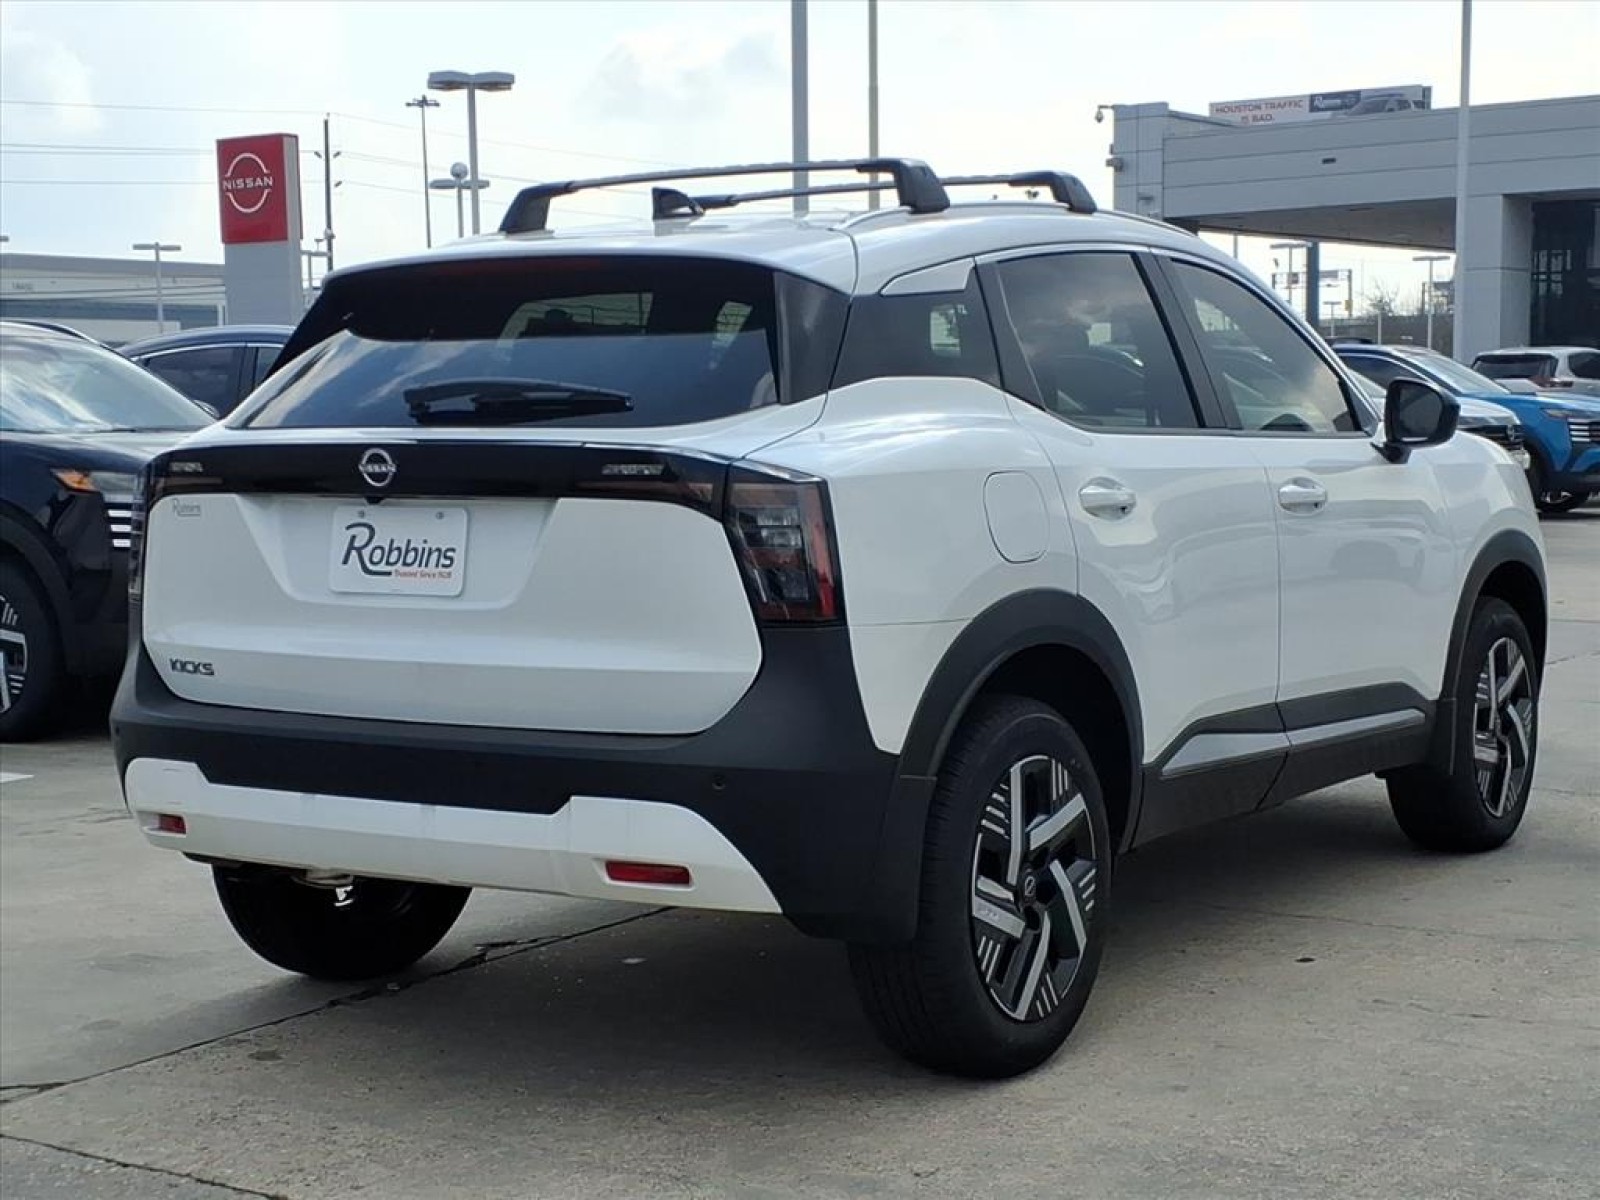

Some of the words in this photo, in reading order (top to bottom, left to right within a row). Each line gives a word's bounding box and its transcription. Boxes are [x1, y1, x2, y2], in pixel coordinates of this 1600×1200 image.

[1215, 103, 1262, 113] HOUSTON
[1264, 99, 1304, 110] TRAFFIC
[222, 176, 273, 190] NISSAN
[341, 521, 457, 576] Robbins
[169, 658, 215, 676] KICKS
